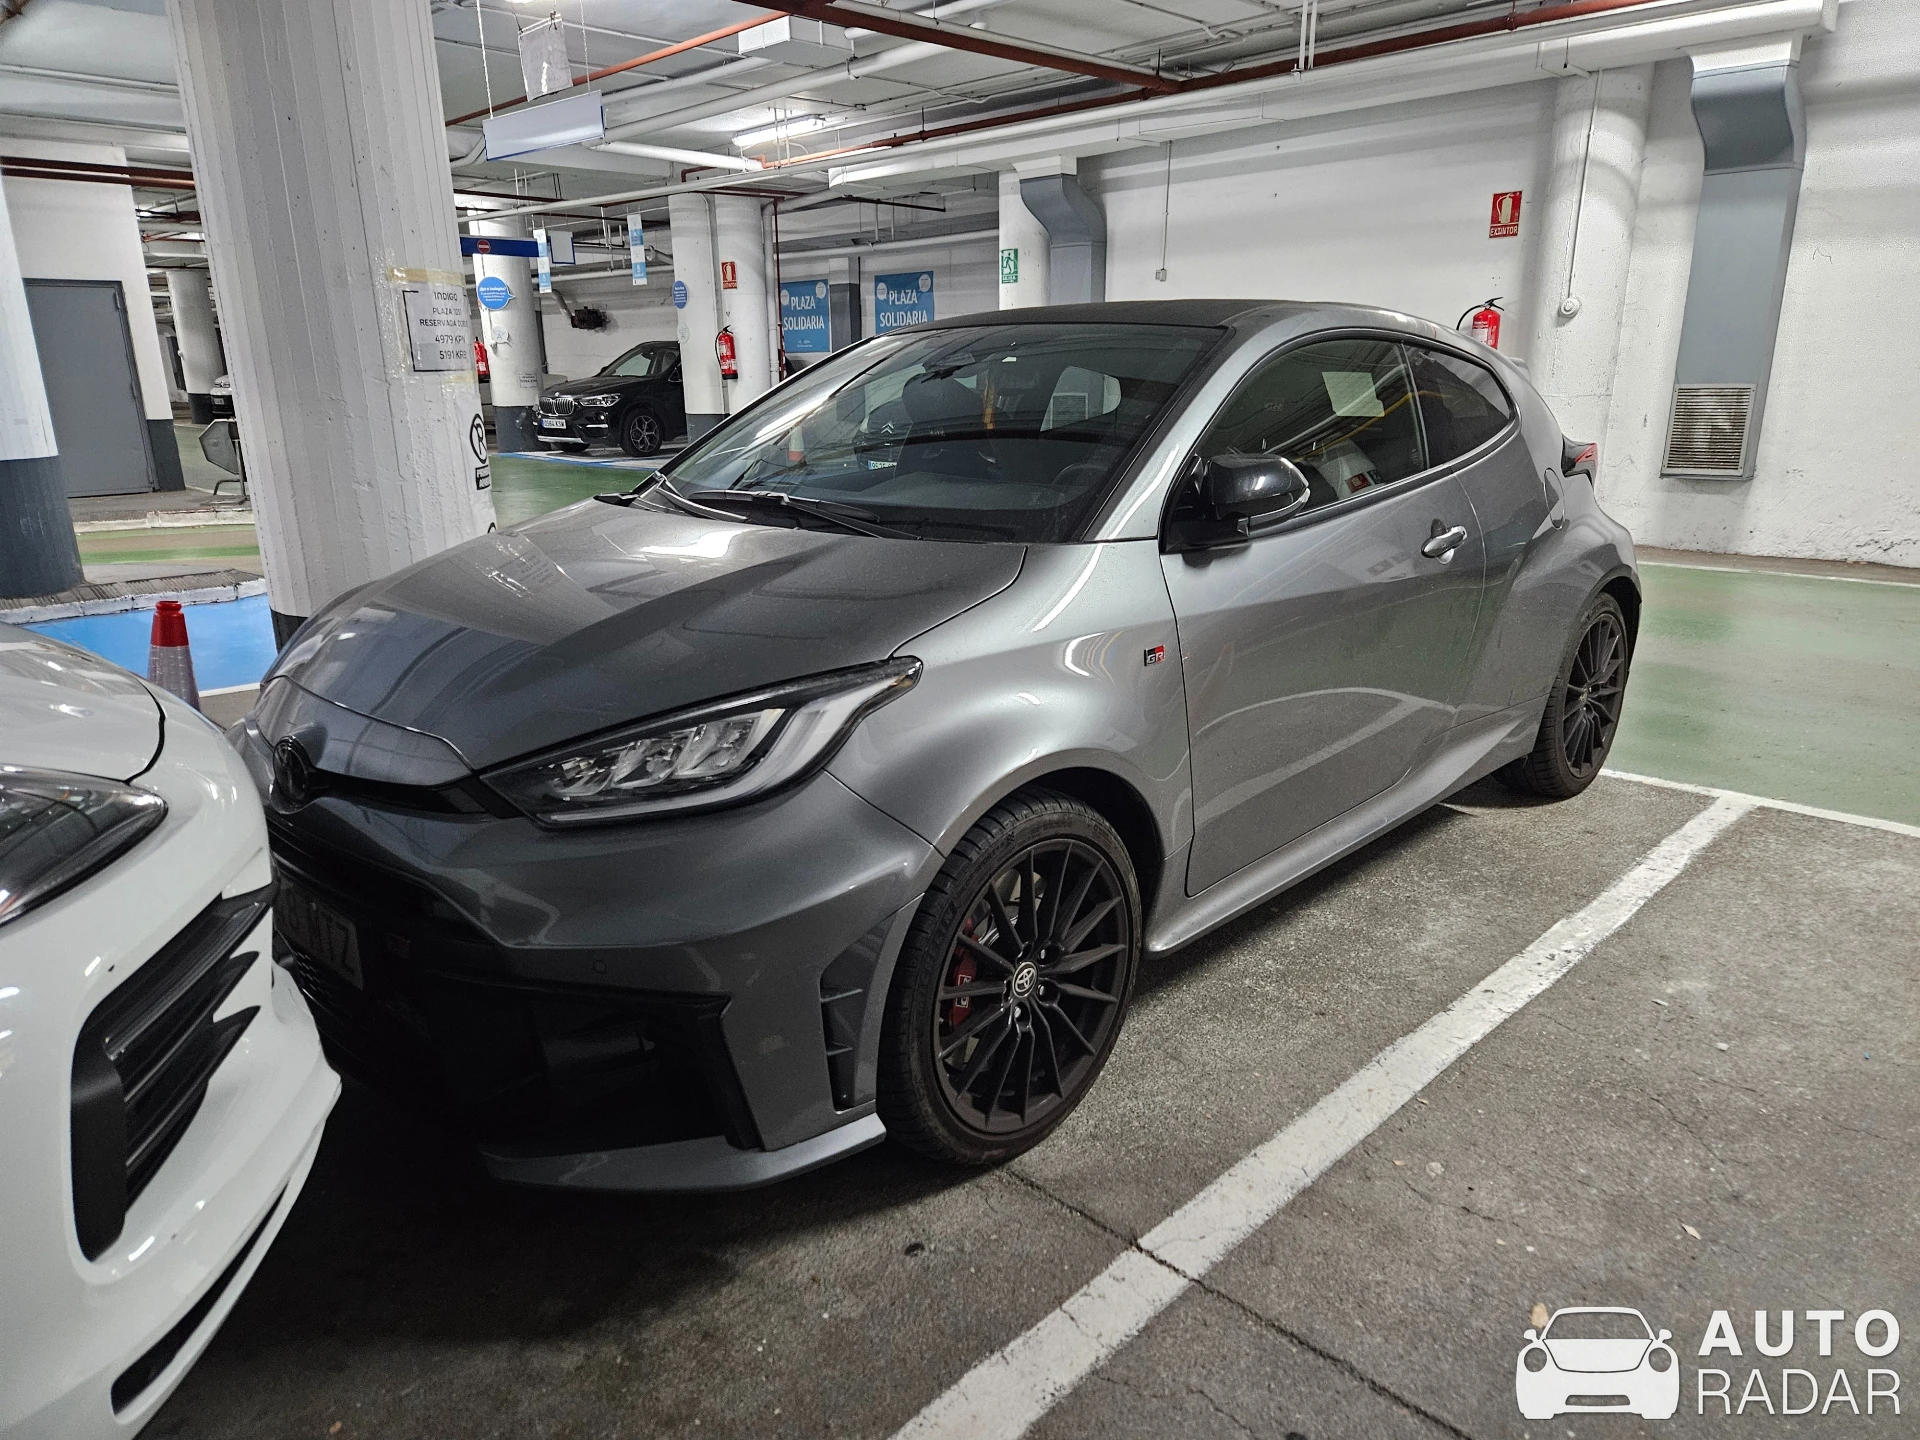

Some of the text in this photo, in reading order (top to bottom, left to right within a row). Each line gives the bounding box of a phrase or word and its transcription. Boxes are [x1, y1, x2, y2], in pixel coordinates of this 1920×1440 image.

[1490, 226, 1518, 236] EXTINTOR
[889, 289, 918, 305] PLAZA
[791, 296, 816, 310] PLAZA
[432, 307, 453, 315] PLAZA
[419, 319, 457, 327] RESERVADA
[783, 315, 825, 331] SOLIDARIA
[880, 310, 928, 327] SOLIDARIA
[435, 334, 454, 344] 4979
[439, 350, 455, 360] 5191
[1147, 652, 1165, 664] GR
